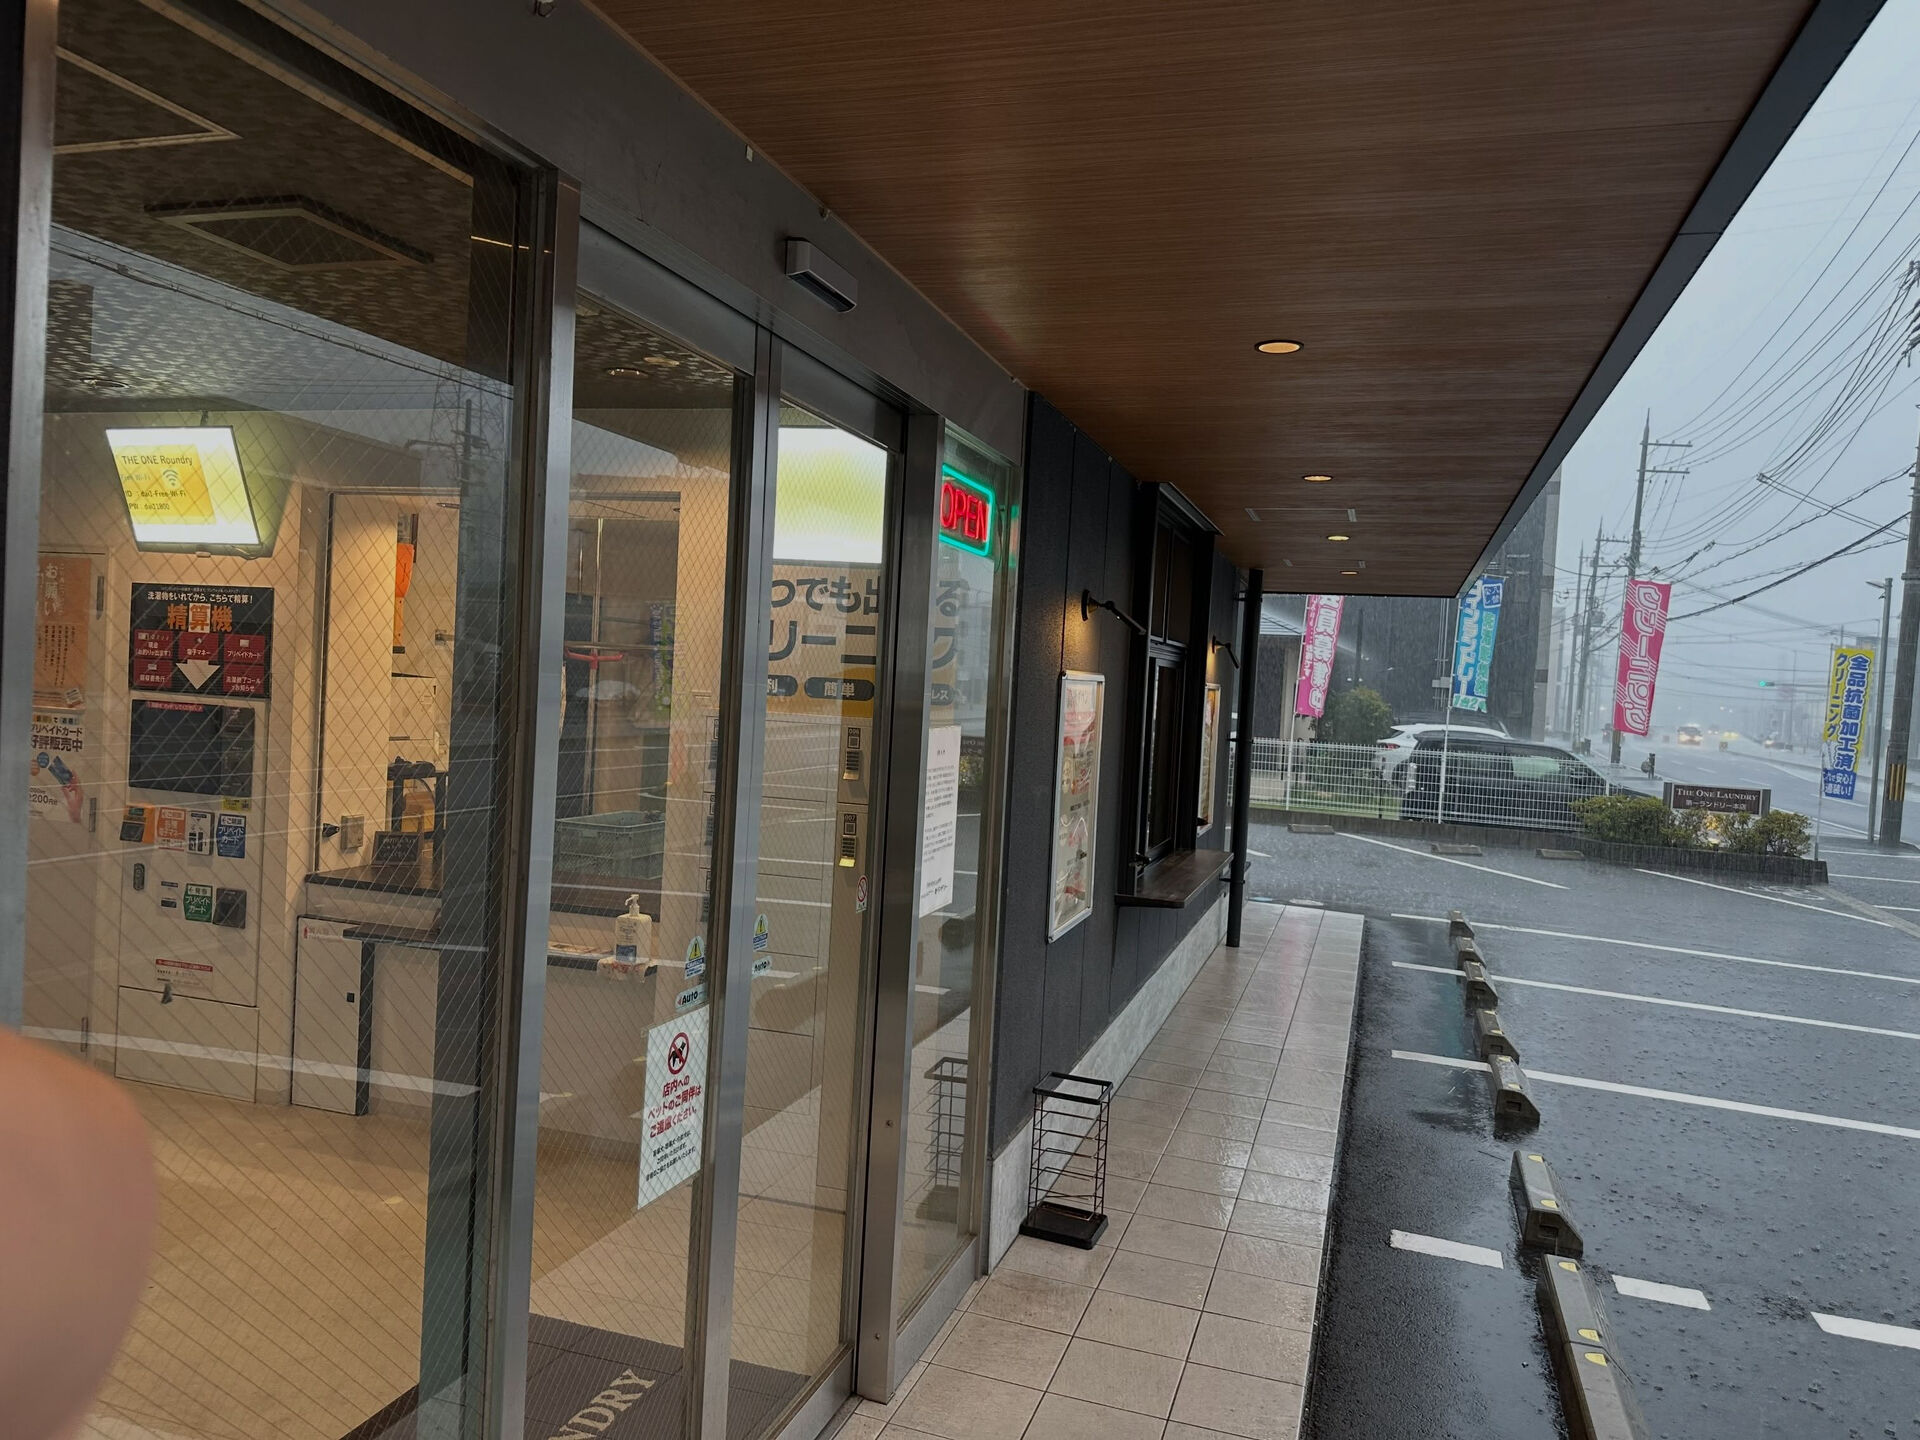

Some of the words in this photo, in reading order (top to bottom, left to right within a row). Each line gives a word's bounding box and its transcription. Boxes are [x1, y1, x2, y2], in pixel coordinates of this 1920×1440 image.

[121, 456, 139, 464] THE
[141, 455, 159, 464] ONE
[160, 456, 193, 466] Roundry
[941, 482, 988, 542] OPEN
[166, 602, 232, 632] 精算機
[824, 681, 855, 698] 簡単
[1826, 652, 1848, 738] クリーニング
[1834, 654, 1871, 771] 全品抗菌加工済
[1676, 787, 1695, 797] THE
[1696, 789, 1716, 798] ONE
[1717, 790, 1758, 801] LAUNDRY
[662, 1074, 690, 1098] 店内への
[647, 1085, 702, 1119] ペットのご同伴は
